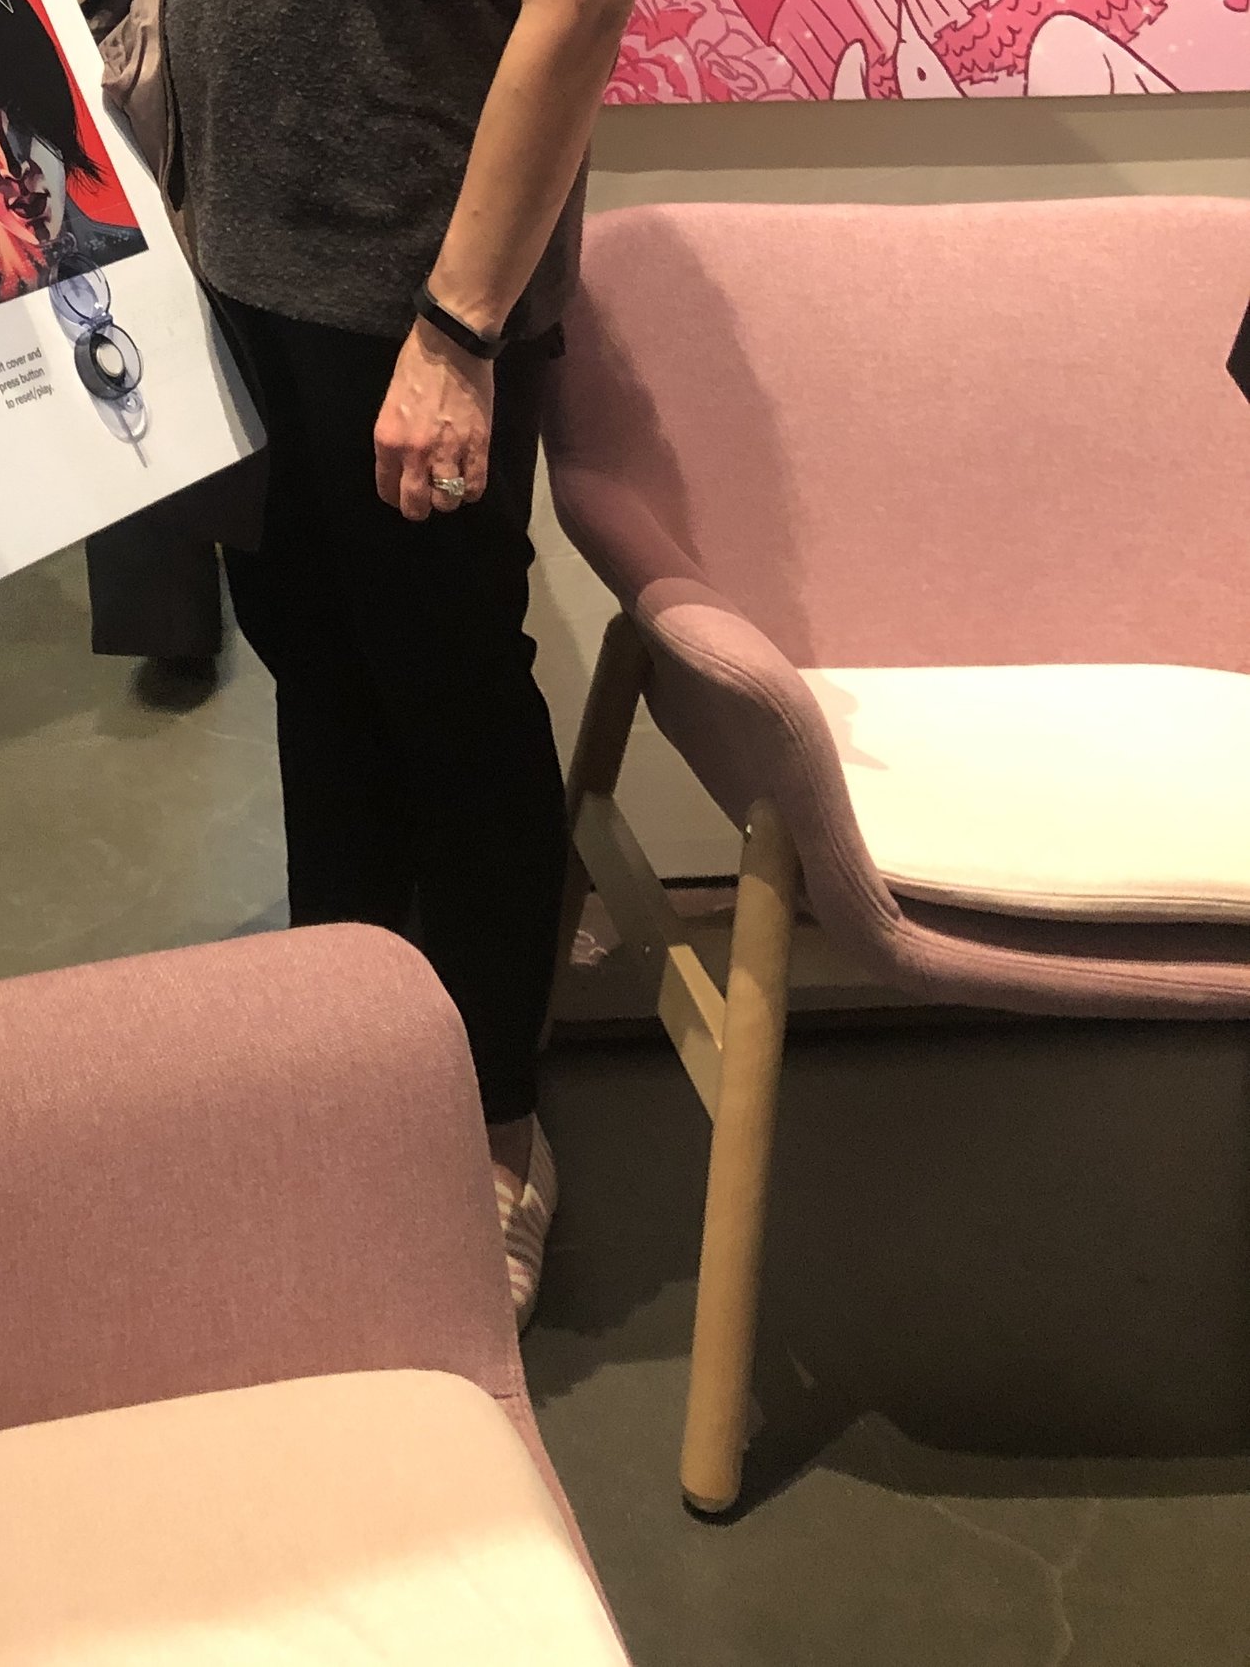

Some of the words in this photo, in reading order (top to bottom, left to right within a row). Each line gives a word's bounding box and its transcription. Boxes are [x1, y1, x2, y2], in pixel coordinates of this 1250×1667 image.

[6, 355, 27, 369] cover
[27, 347, 42, 361] and
[18, 367, 45, 384] button
[5, 399, 15, 409] to
